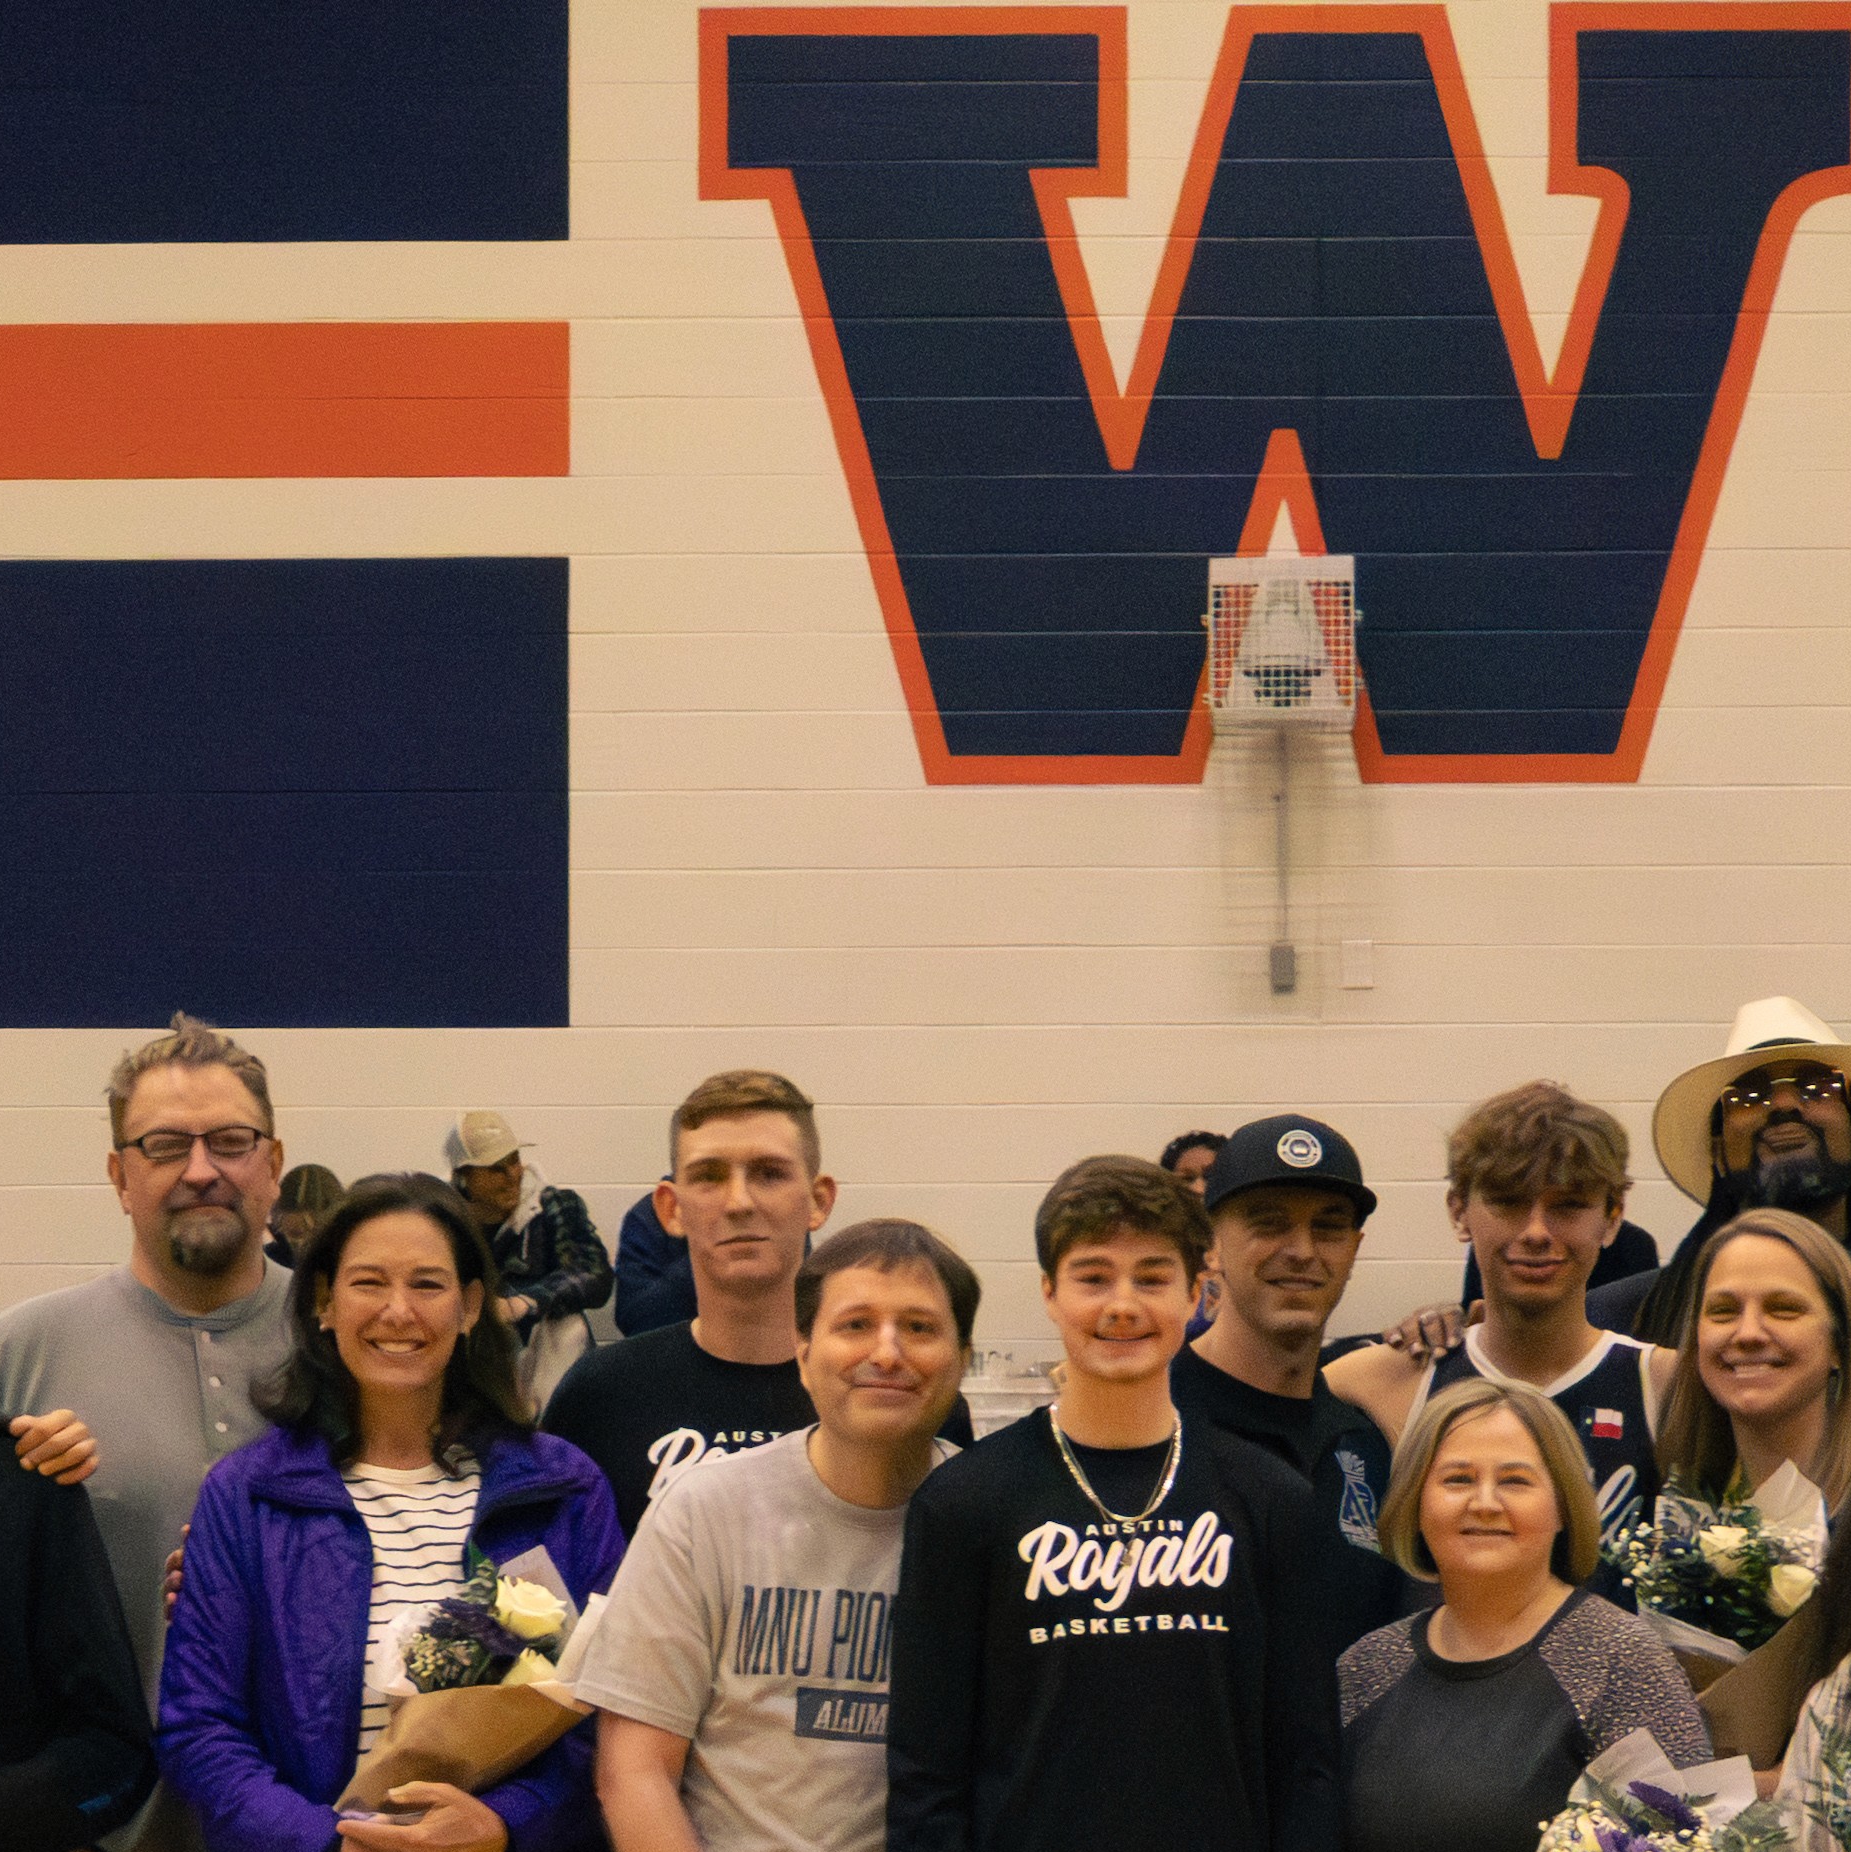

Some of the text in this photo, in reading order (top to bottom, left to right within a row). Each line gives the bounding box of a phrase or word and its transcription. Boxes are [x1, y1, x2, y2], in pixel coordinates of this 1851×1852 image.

[1085, 1519, 1185, 1537] AUSTIN
[1017, 1510, 1235, 1612] Royals
[734, 1585, 821, 1677] MNU
[1028, 1614, 1231, 1645] BASKETBALL
